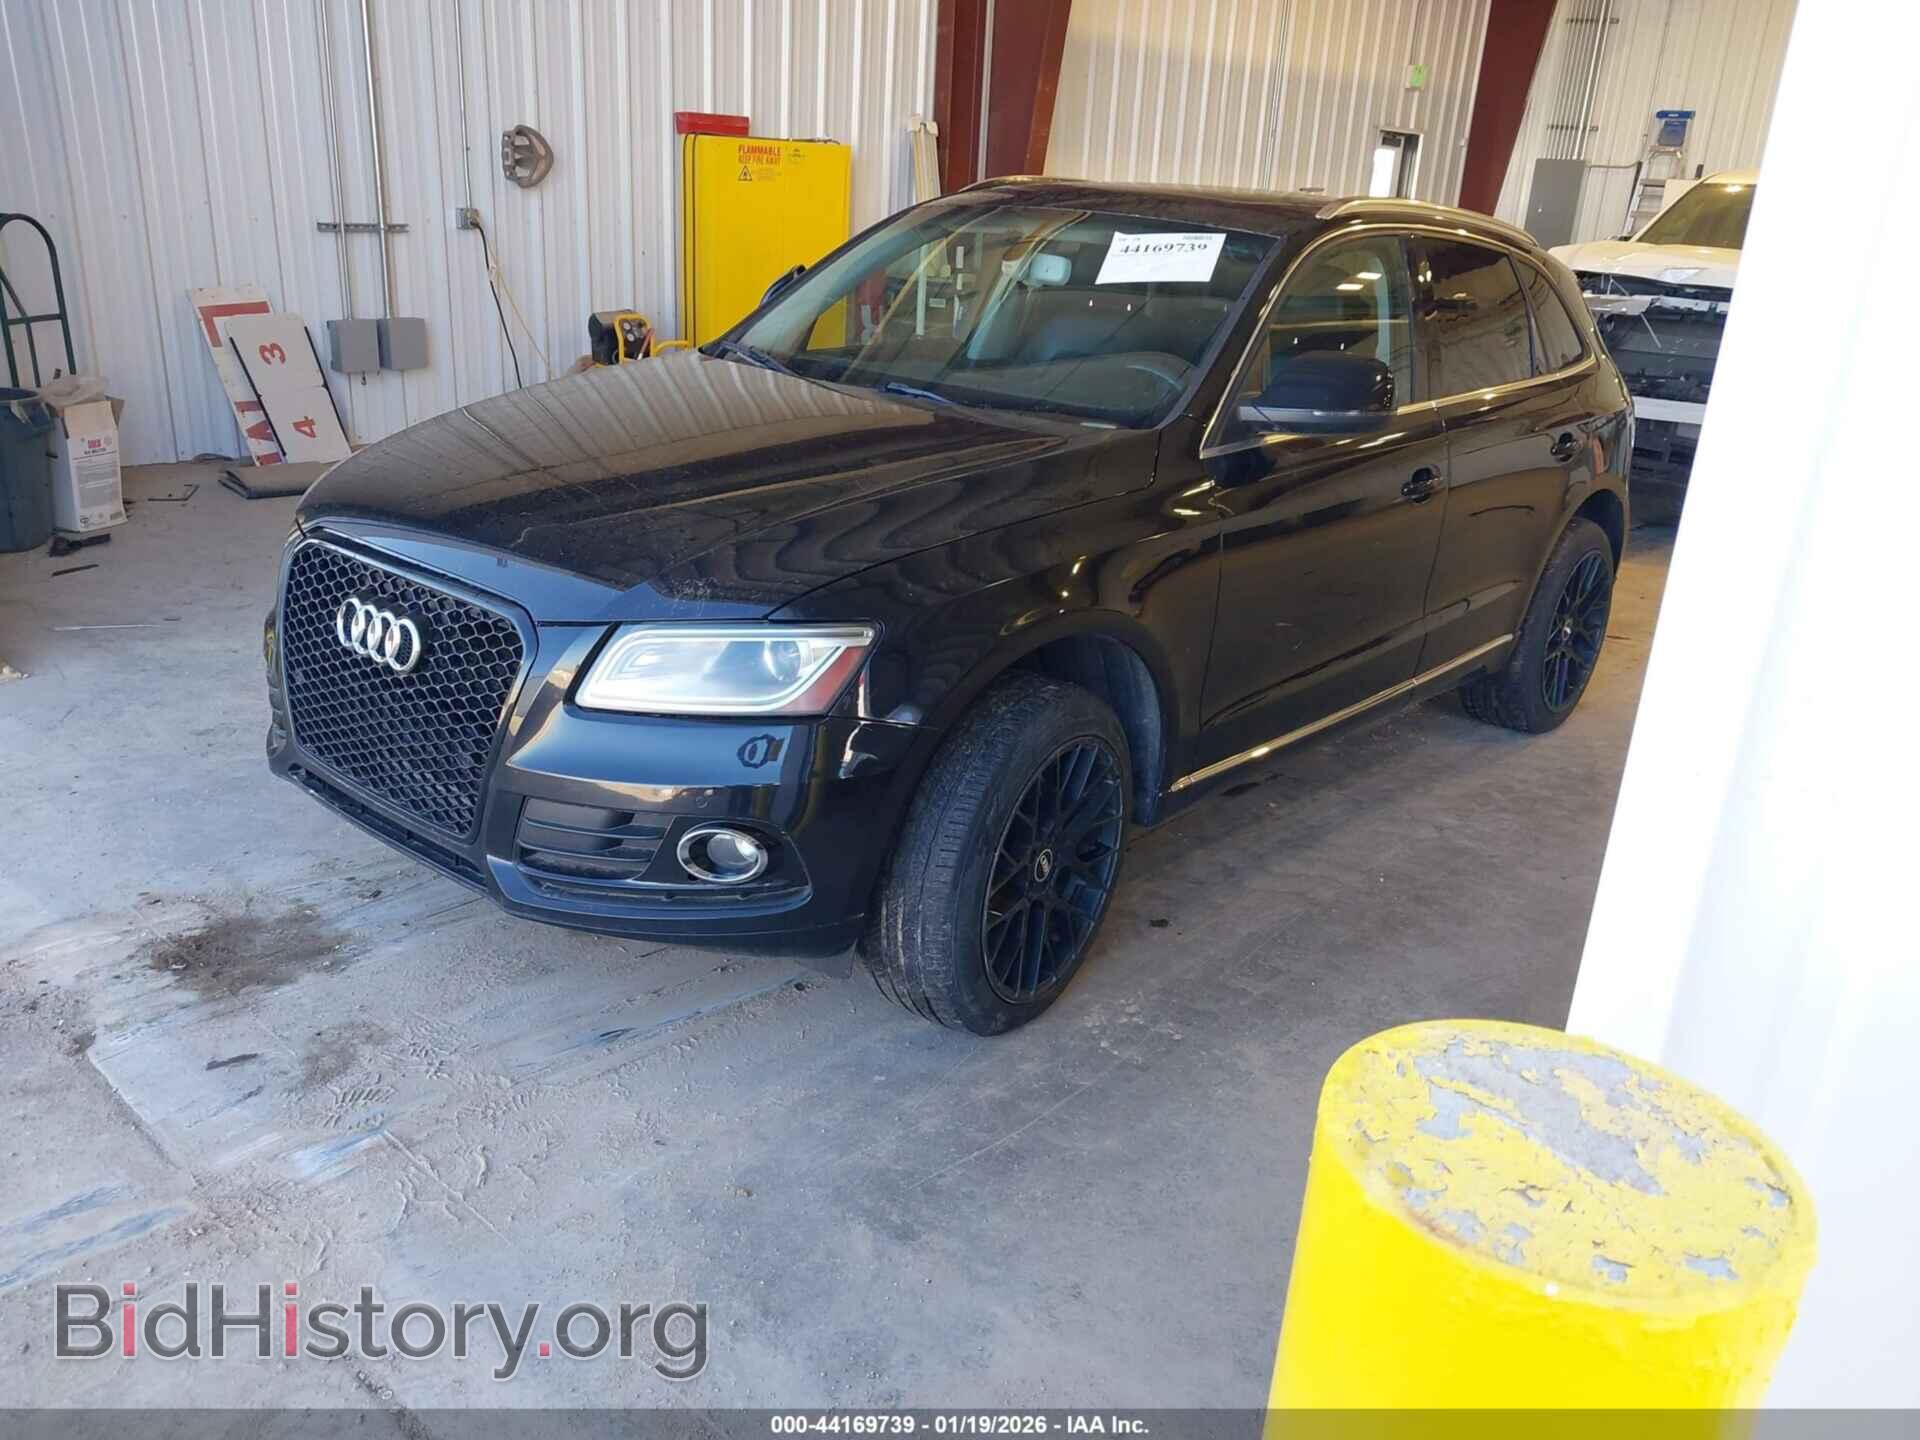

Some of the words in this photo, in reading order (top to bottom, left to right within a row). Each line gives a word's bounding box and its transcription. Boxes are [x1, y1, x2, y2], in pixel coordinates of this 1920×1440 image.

[738, 144, 781, 158] FLAMMABLE
[1119, 242, 1208, 255] 44169739
[258, 342, 286, 366] 3
[292, 415, 317, 439] 4
